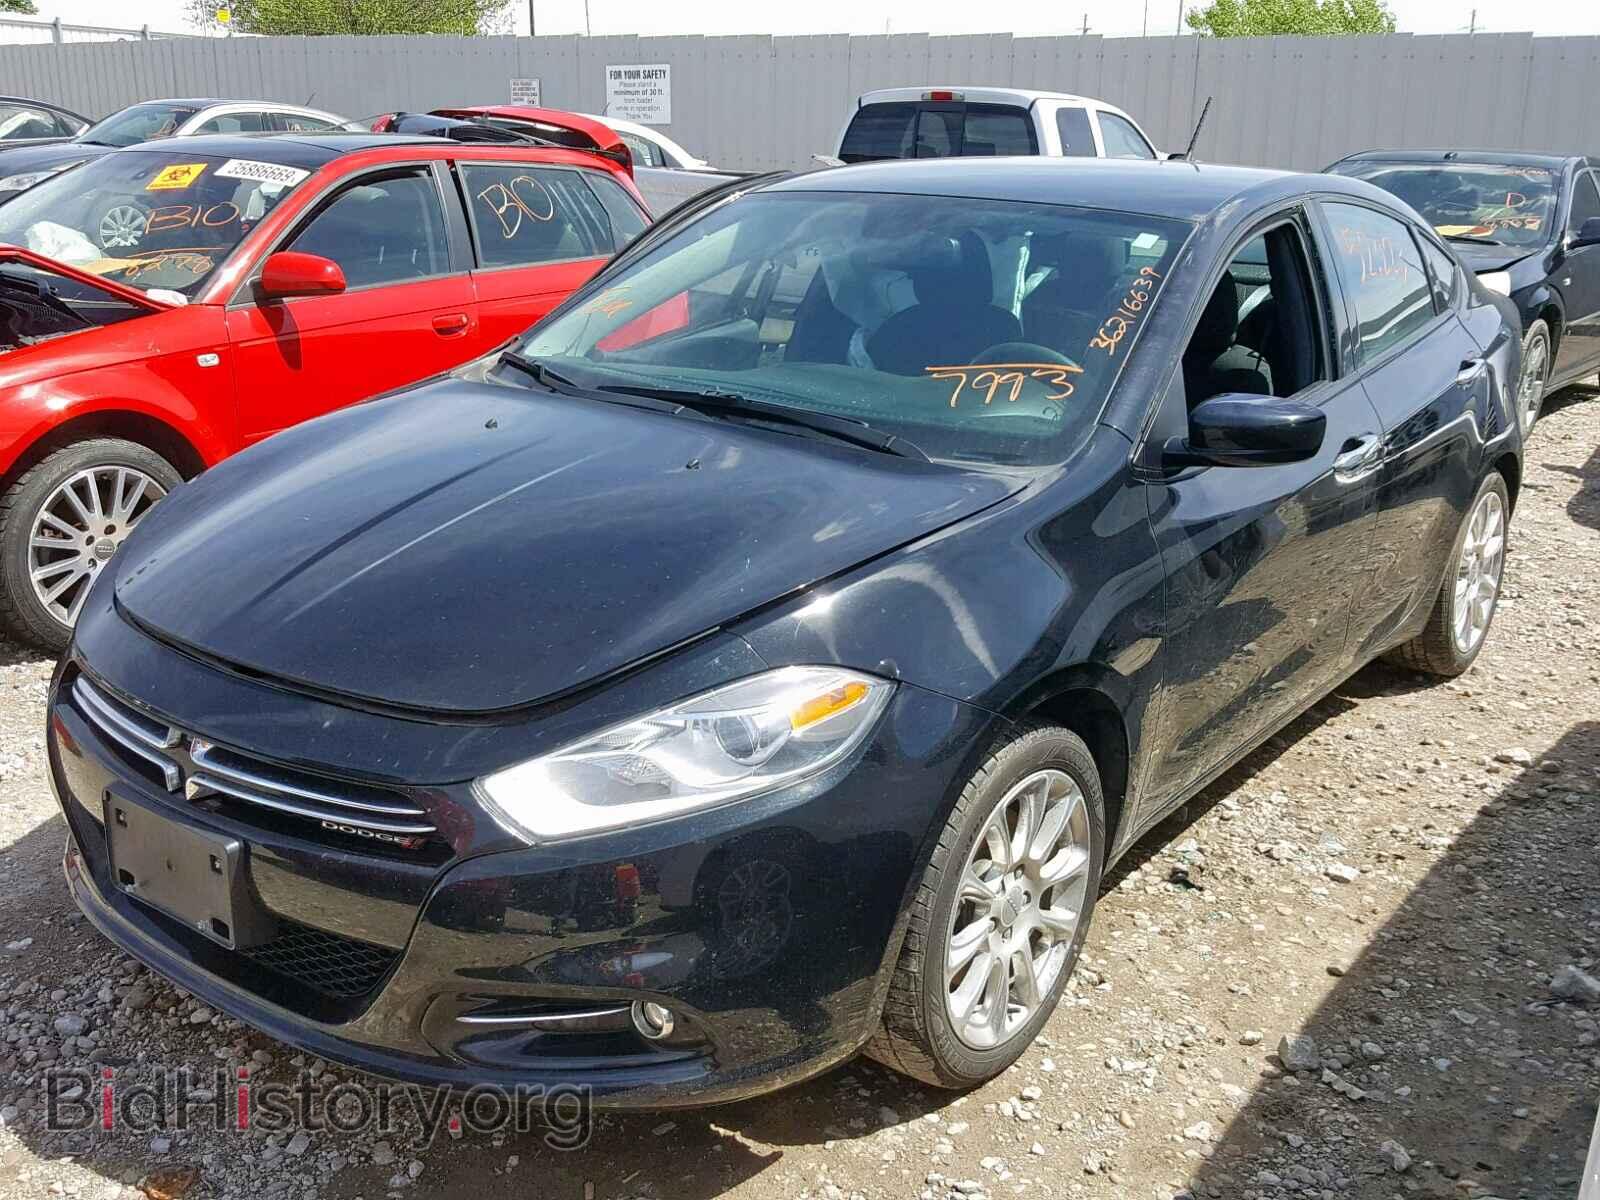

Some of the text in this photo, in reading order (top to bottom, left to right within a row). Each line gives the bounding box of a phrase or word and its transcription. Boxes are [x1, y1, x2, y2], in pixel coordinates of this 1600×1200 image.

[609, 69, 667, 80] FOR YOUR SAFETY
[641, 88, 648, 96] of
[931, 368, 1075, 408] 7993
[321, 820, 412, 846] DODGE
